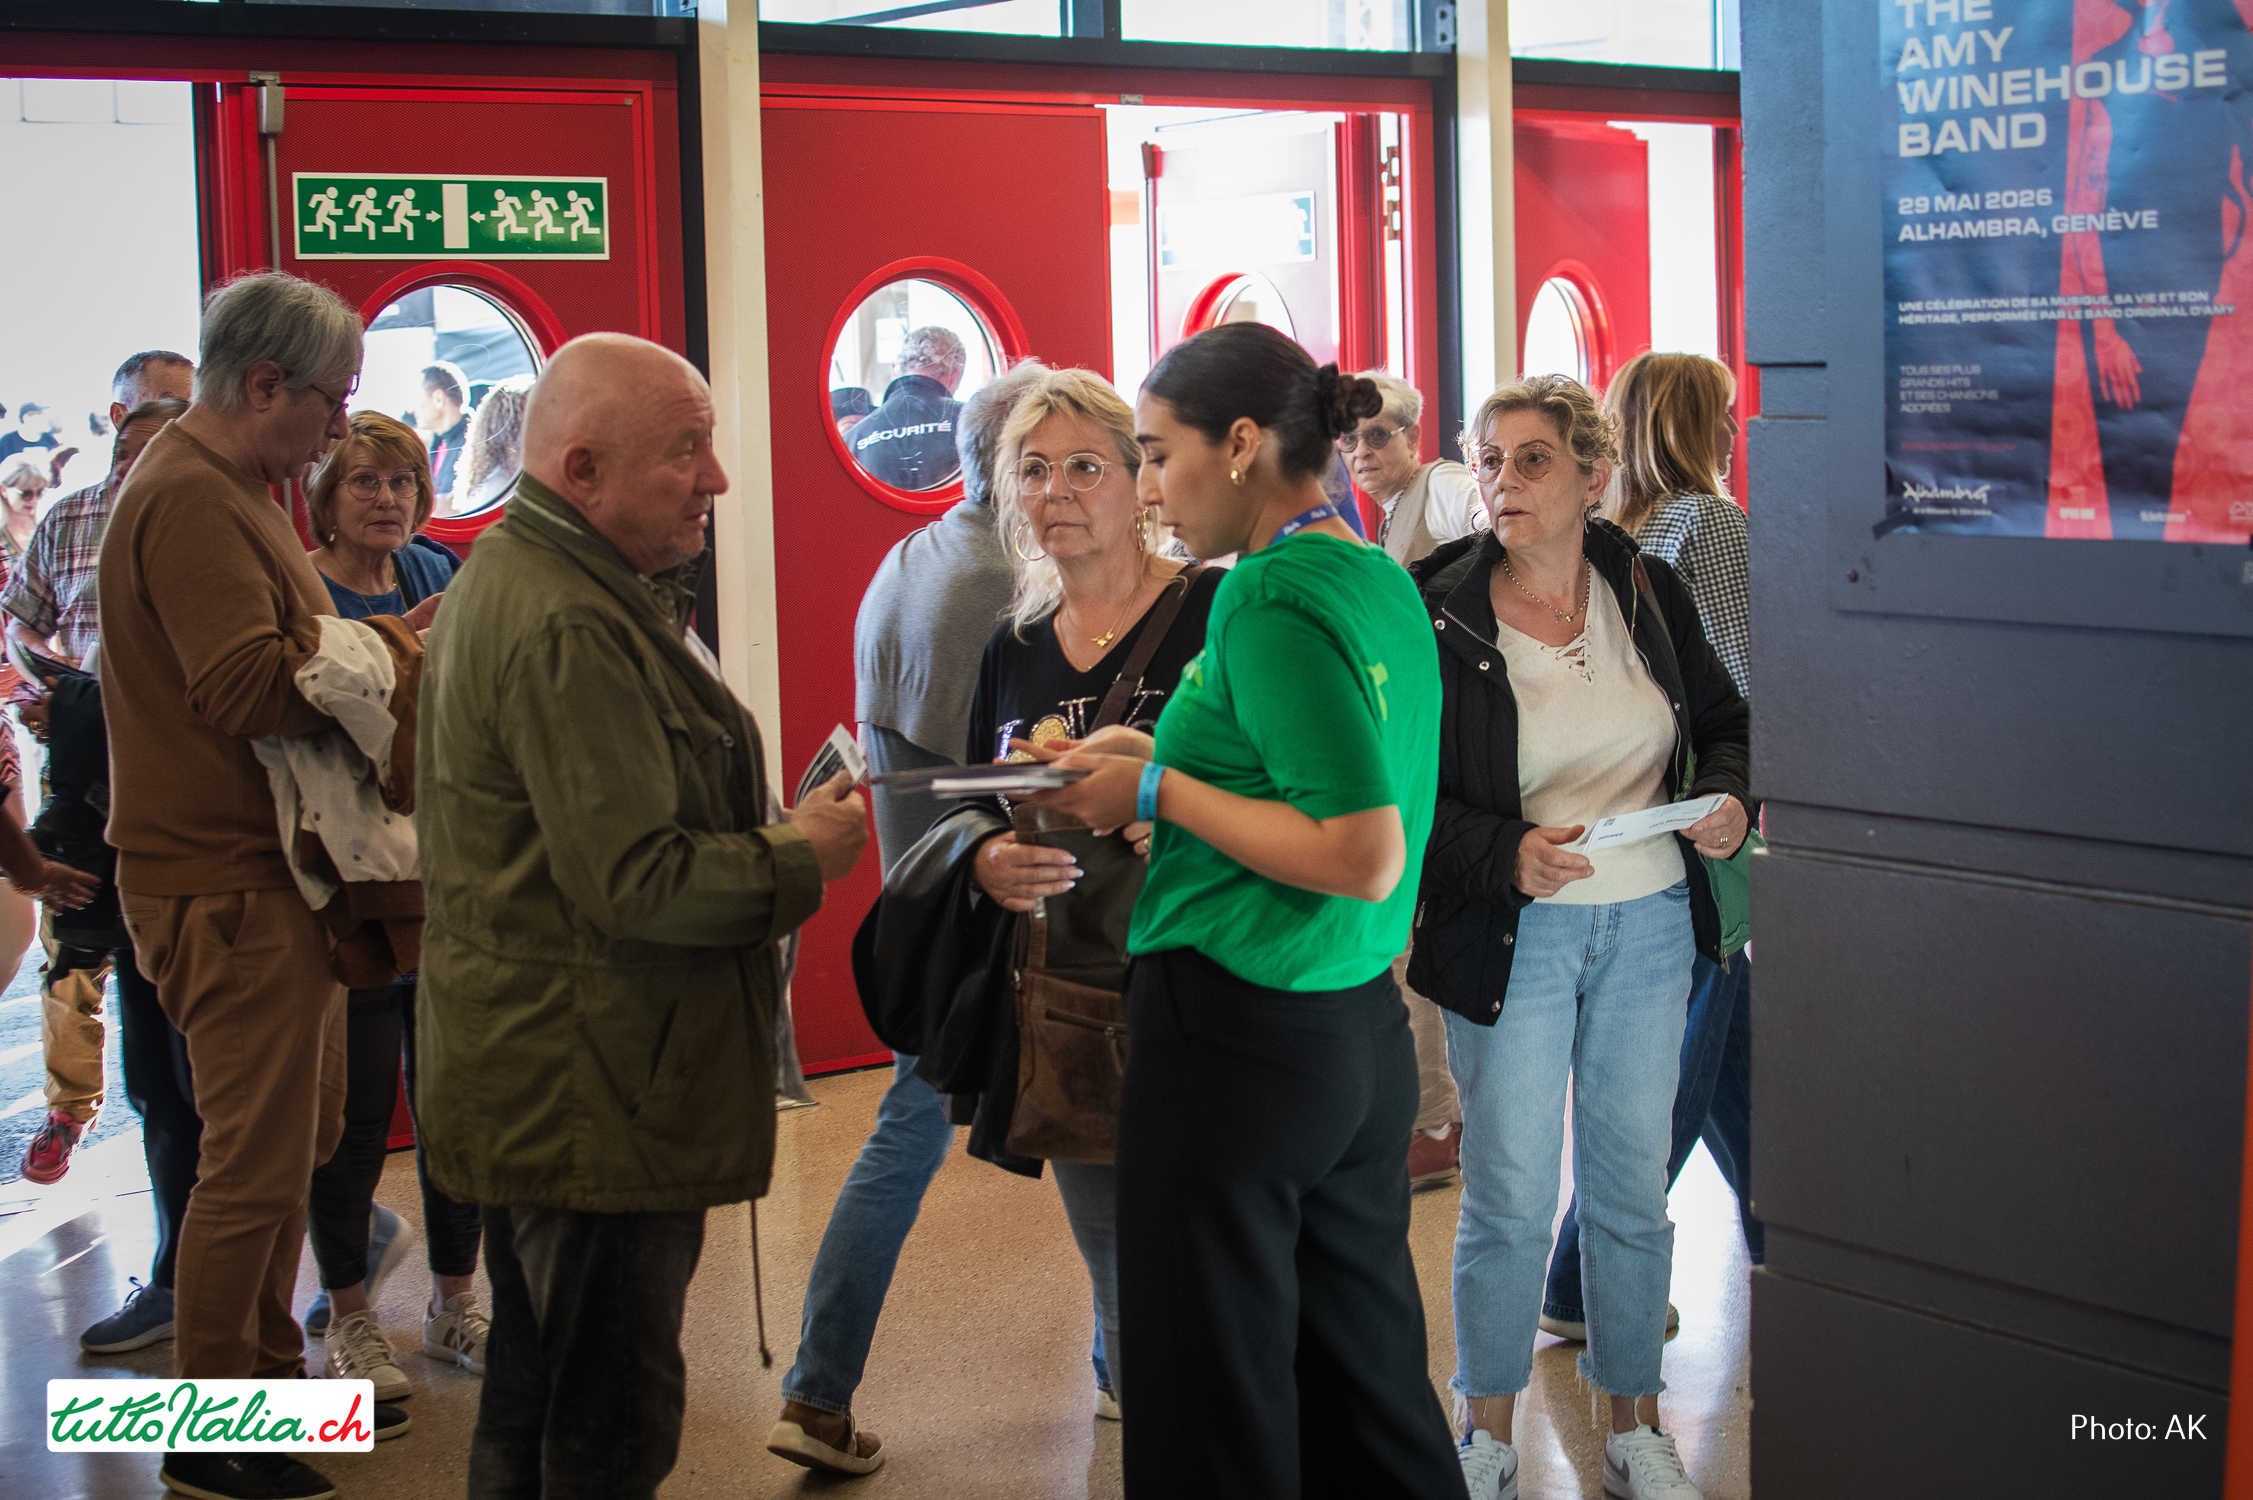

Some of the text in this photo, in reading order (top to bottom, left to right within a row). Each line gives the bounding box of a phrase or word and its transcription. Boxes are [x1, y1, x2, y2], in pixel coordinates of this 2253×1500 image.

[1896, 0, 1993, 28] THE
[1897, 27, 2013, 72] AMY
[1898, 49, 2227, 114] WINEHOUSE
[1899, 113, 2047, 157] BAND
[1899, 188, 2052, 215] 29 MAI 2026
[1899, 208, 2158, 242] ALHAMBRA, GENÈVE
[1899, 301, 1923, 311] UNE
[2011, 297, 2028, 308] DE
[2159, 292, 2176, 303] ET
[2085, 308, 2122, 319] BAND
[2125, 305, 2187, 318] ORIGINAL
[856, 419, 953, 450] SÉCURITÉ
